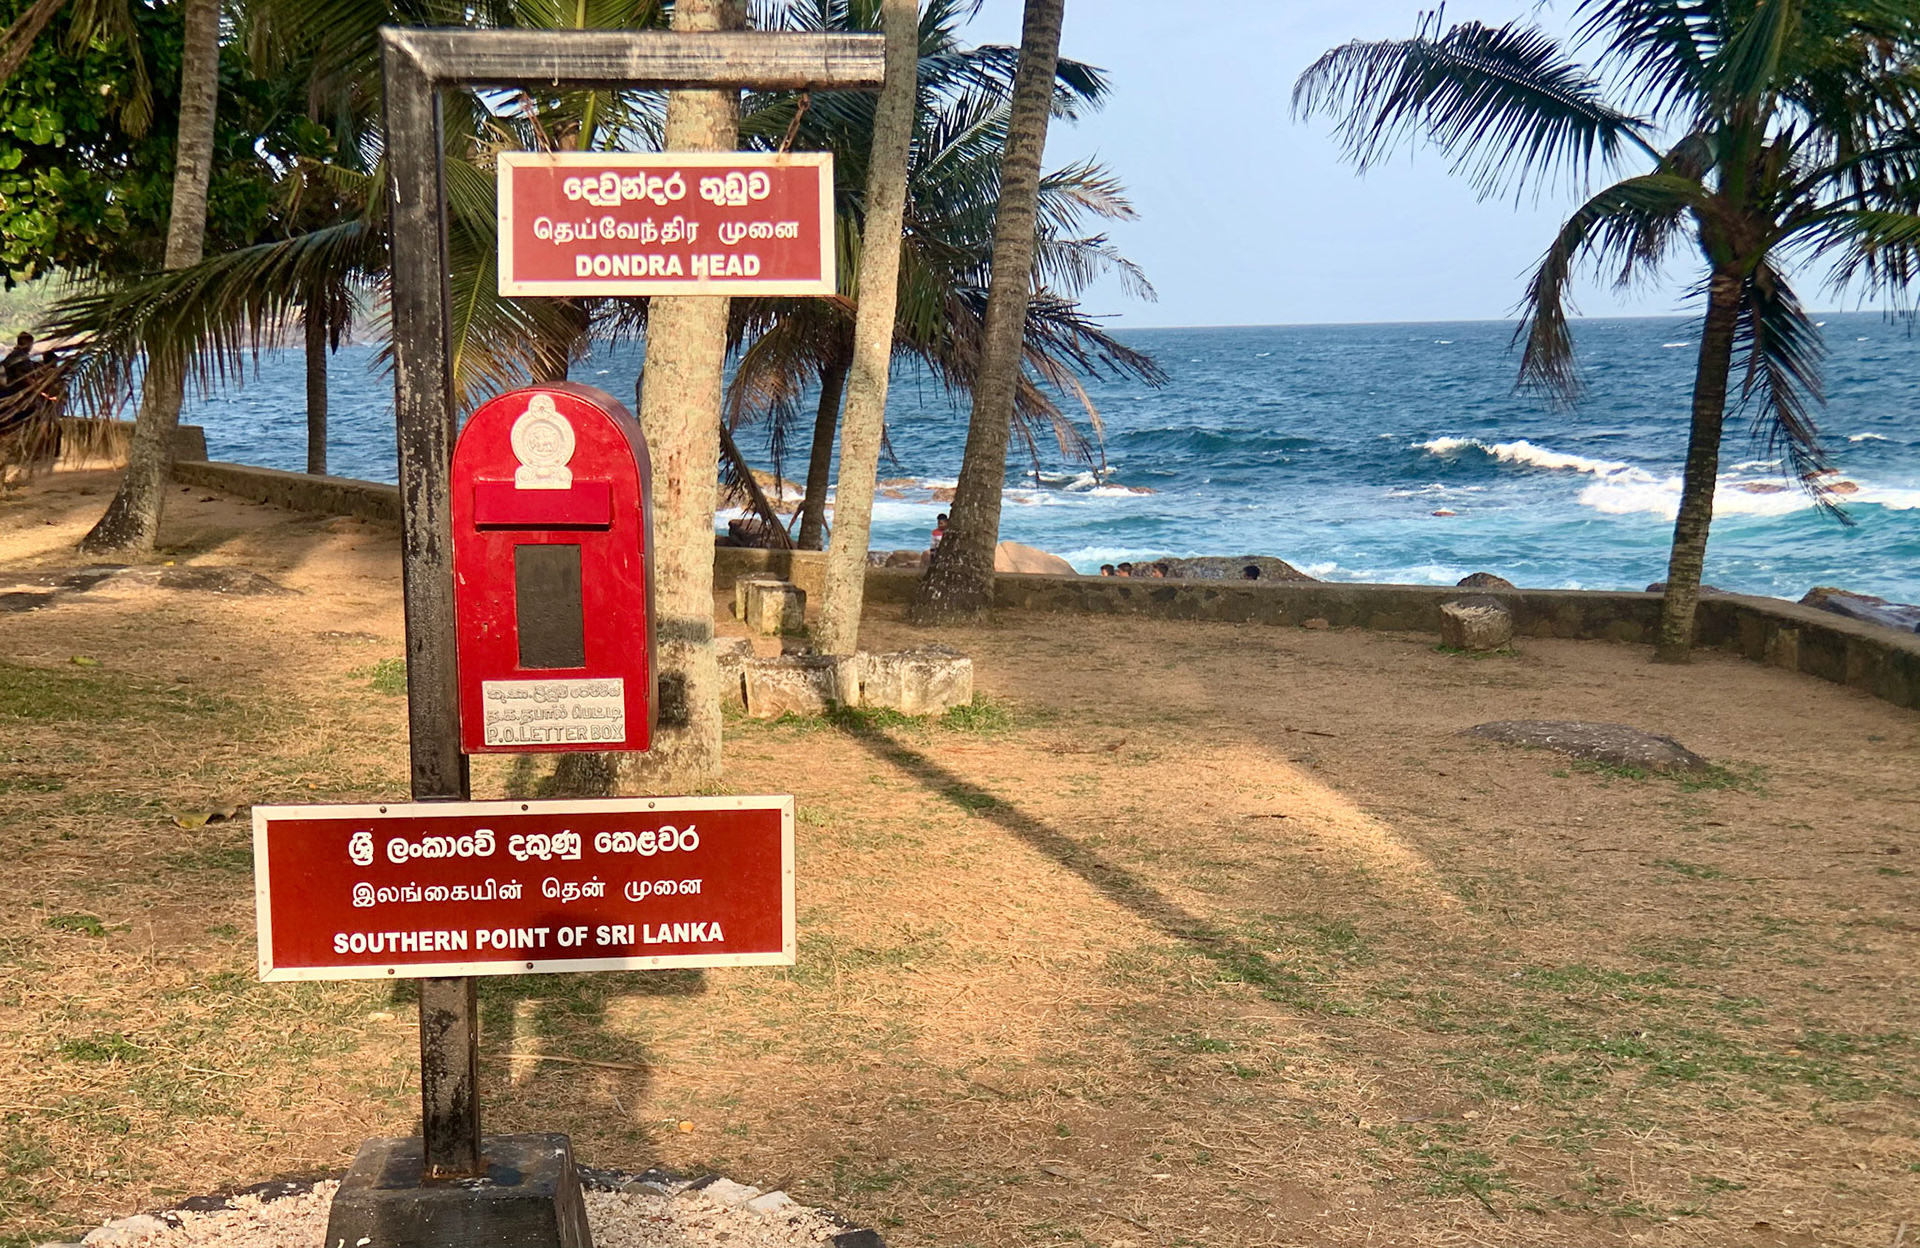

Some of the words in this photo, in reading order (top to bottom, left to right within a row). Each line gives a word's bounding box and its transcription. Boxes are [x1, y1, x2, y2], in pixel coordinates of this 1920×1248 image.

[563, 170, 687, 206] දෙවුන්දර
[699, 171, 771, 206] තුඩුව
[533, 216, 700, 245] தெய்வேந்திர
[718, 221, 800, 245] முனை
[575, 254, 684, 277] DONDRA
[690, 254, 761, 277] HEAD
[591, 724, 624, 741] BOX
[348, 831, 374, 866] ශ්‍රී
[386, 829, 496, 864] ලංකාවේ
[508, 830, 582, 862] දකුණු
[594, 825, 700, 855] කෙළවර
[352, 878, 523, 907] இலங்கையின்
[541, 876, 606, 904] தென்
[624, 879, 703, 903] முனை
[333, 929, 468, 953] SOUTHERN
[475, 927, 550, 950] POINT
[557, 926, 589, 946] OF
[596, 924, 635, 945] SRI
[642, 922, 725, 944] LANKA
